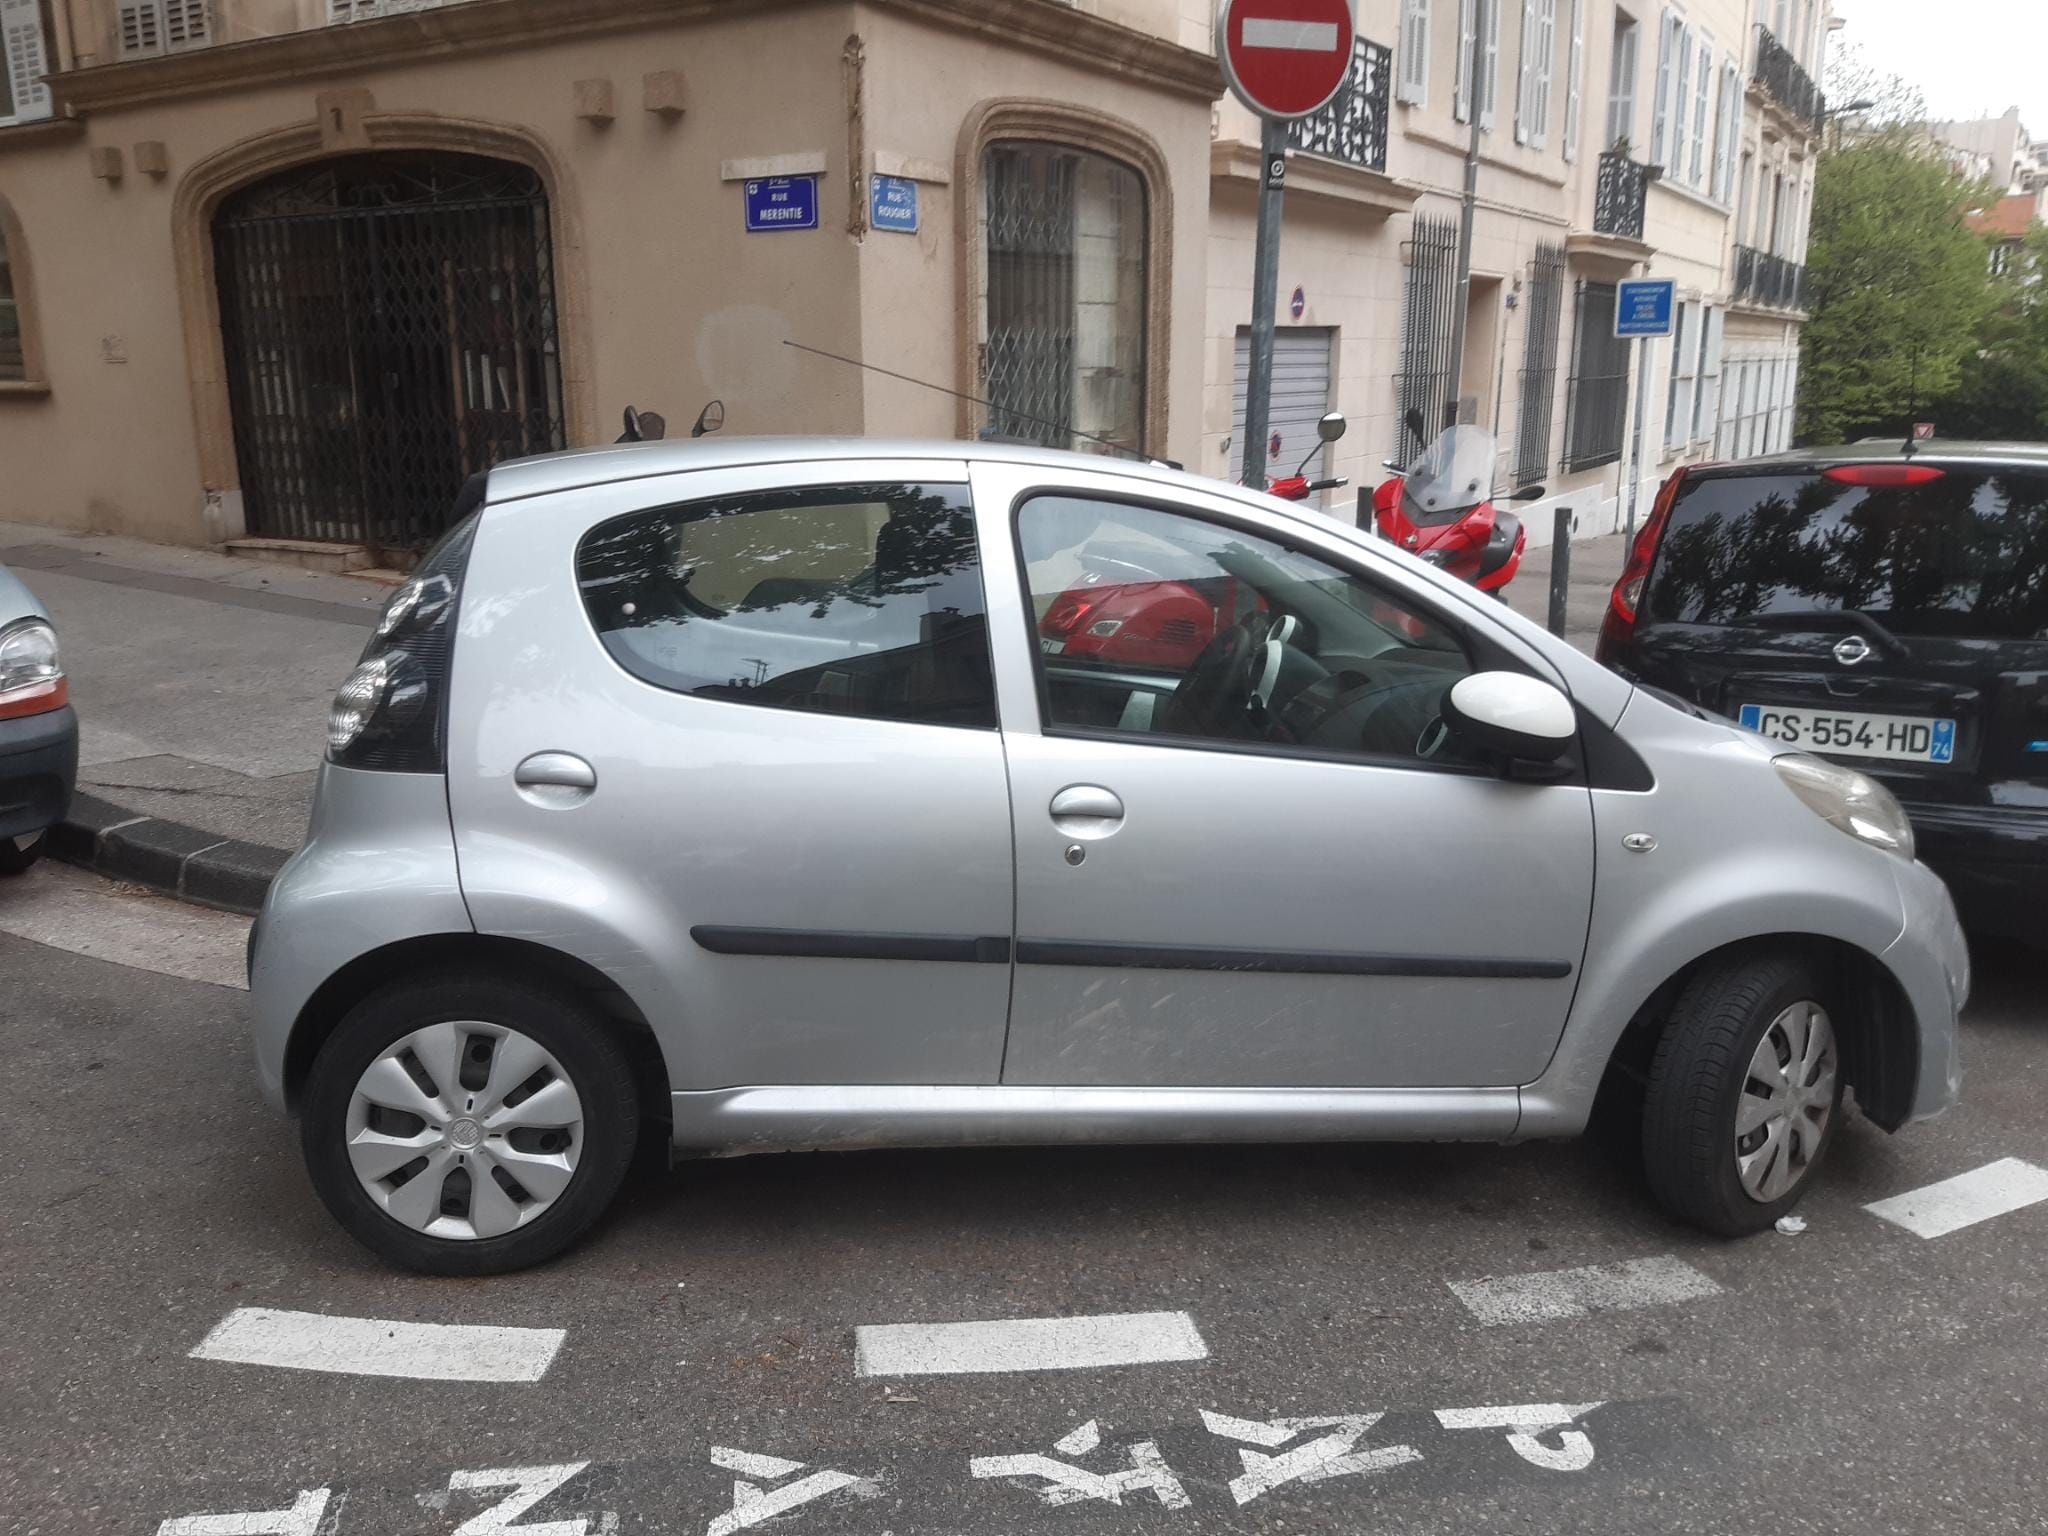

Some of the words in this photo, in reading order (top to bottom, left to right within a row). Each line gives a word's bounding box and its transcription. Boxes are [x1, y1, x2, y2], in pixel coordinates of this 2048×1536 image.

[771, 192, 788, 202] RUE
[1761, 713, 1931, 753] CS-554-HD
[1932, 742, 1950, 757] 74
